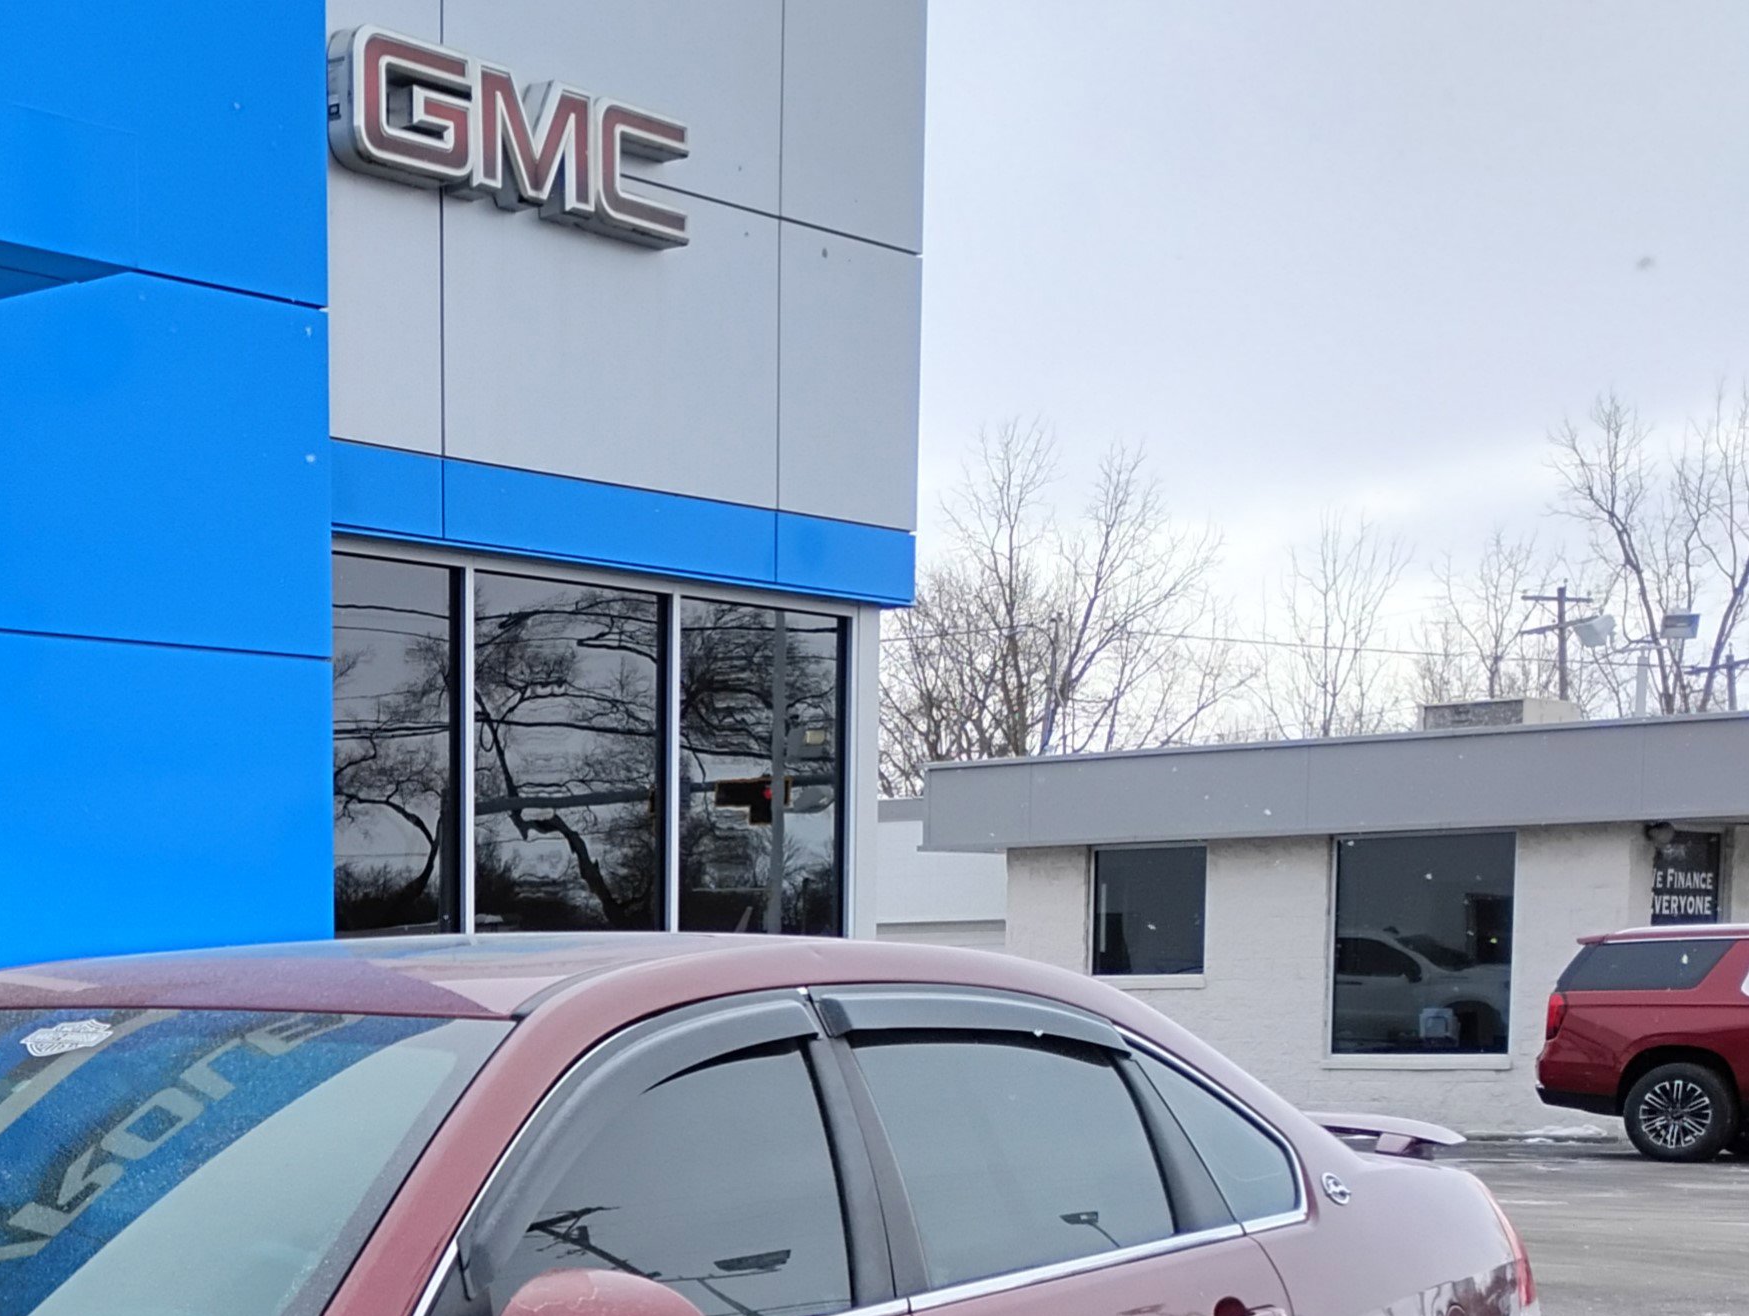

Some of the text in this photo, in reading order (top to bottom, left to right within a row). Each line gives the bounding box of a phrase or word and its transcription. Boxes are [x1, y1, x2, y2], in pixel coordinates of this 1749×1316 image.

[334, 23, 690, 251] GMC
[1666, 868, 1714, 889] FINANCE
[1651, 893, 1712, 914] VERYONE
